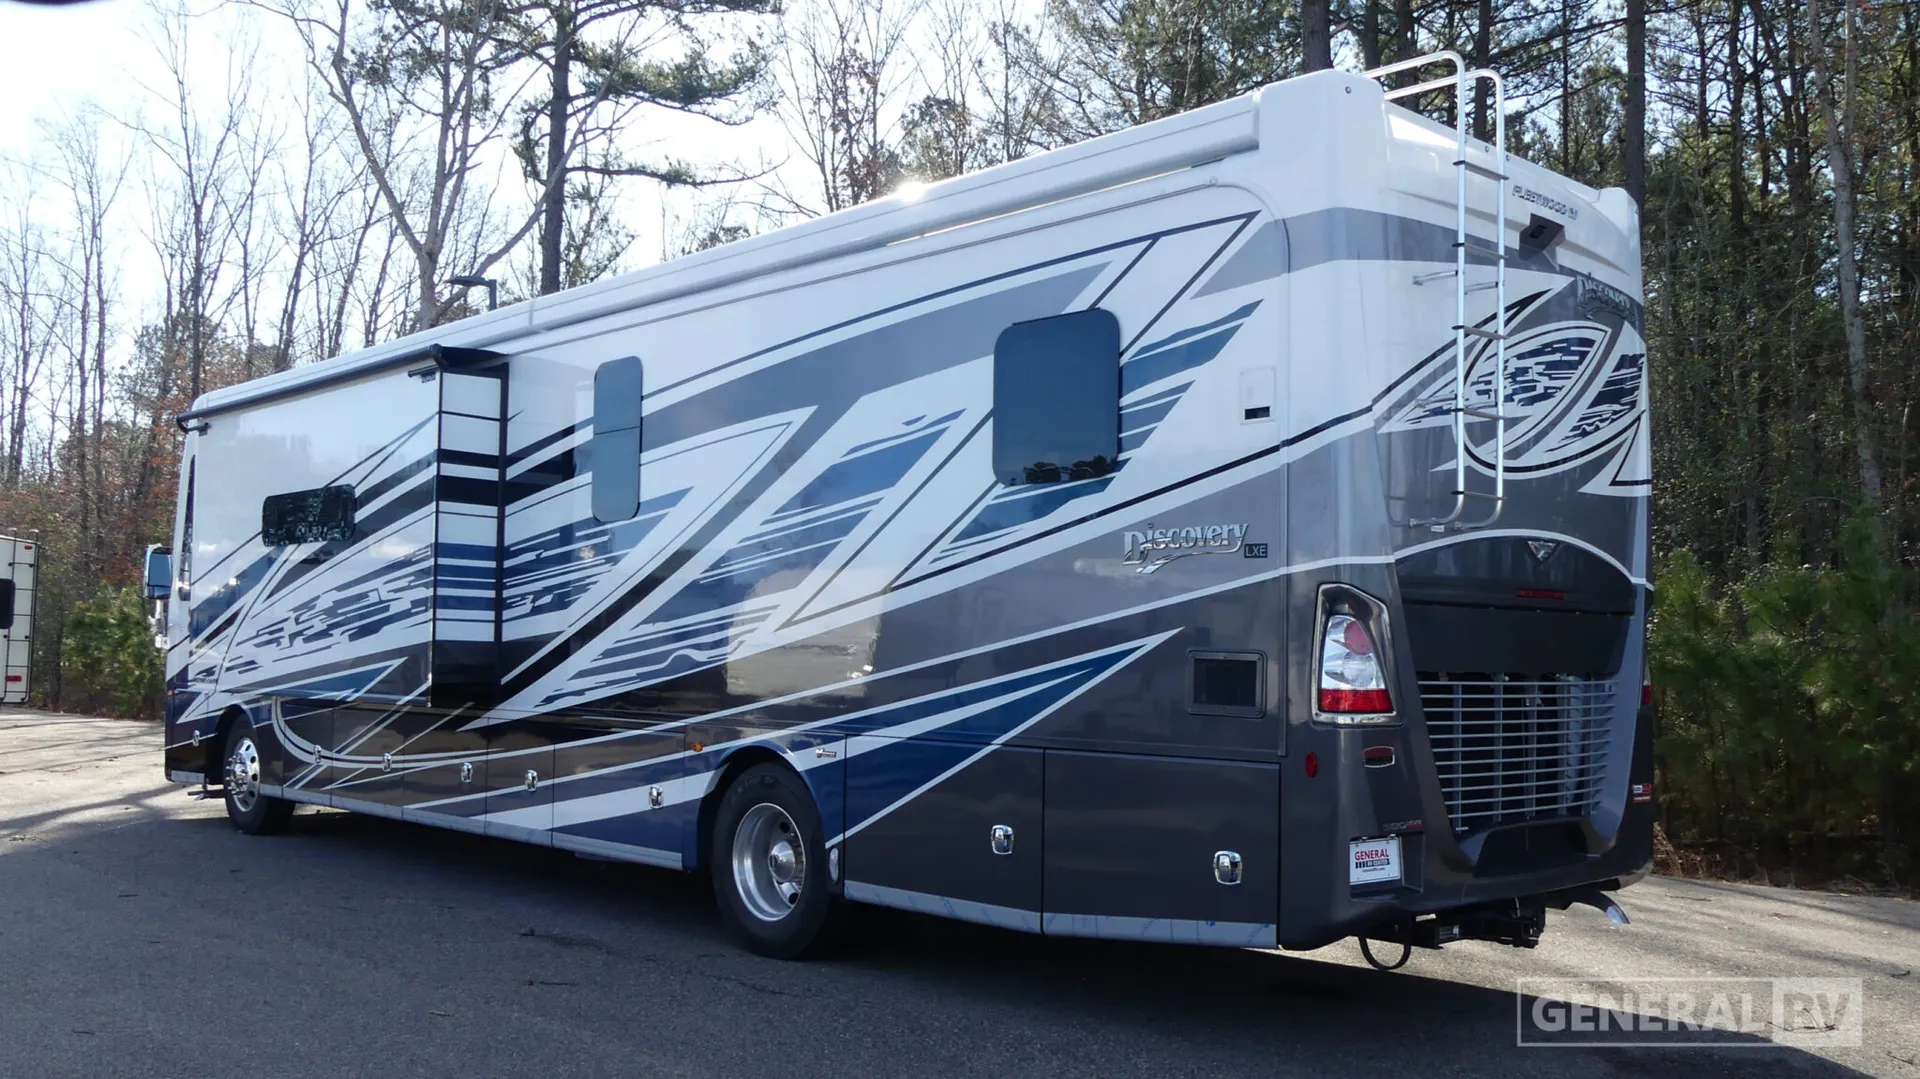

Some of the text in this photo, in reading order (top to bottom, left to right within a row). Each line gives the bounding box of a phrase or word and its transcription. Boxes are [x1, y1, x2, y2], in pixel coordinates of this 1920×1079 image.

[1123, 523, 1267, 573] Discovery LXE
[1355, 849, 1389, 861] GENERAL
